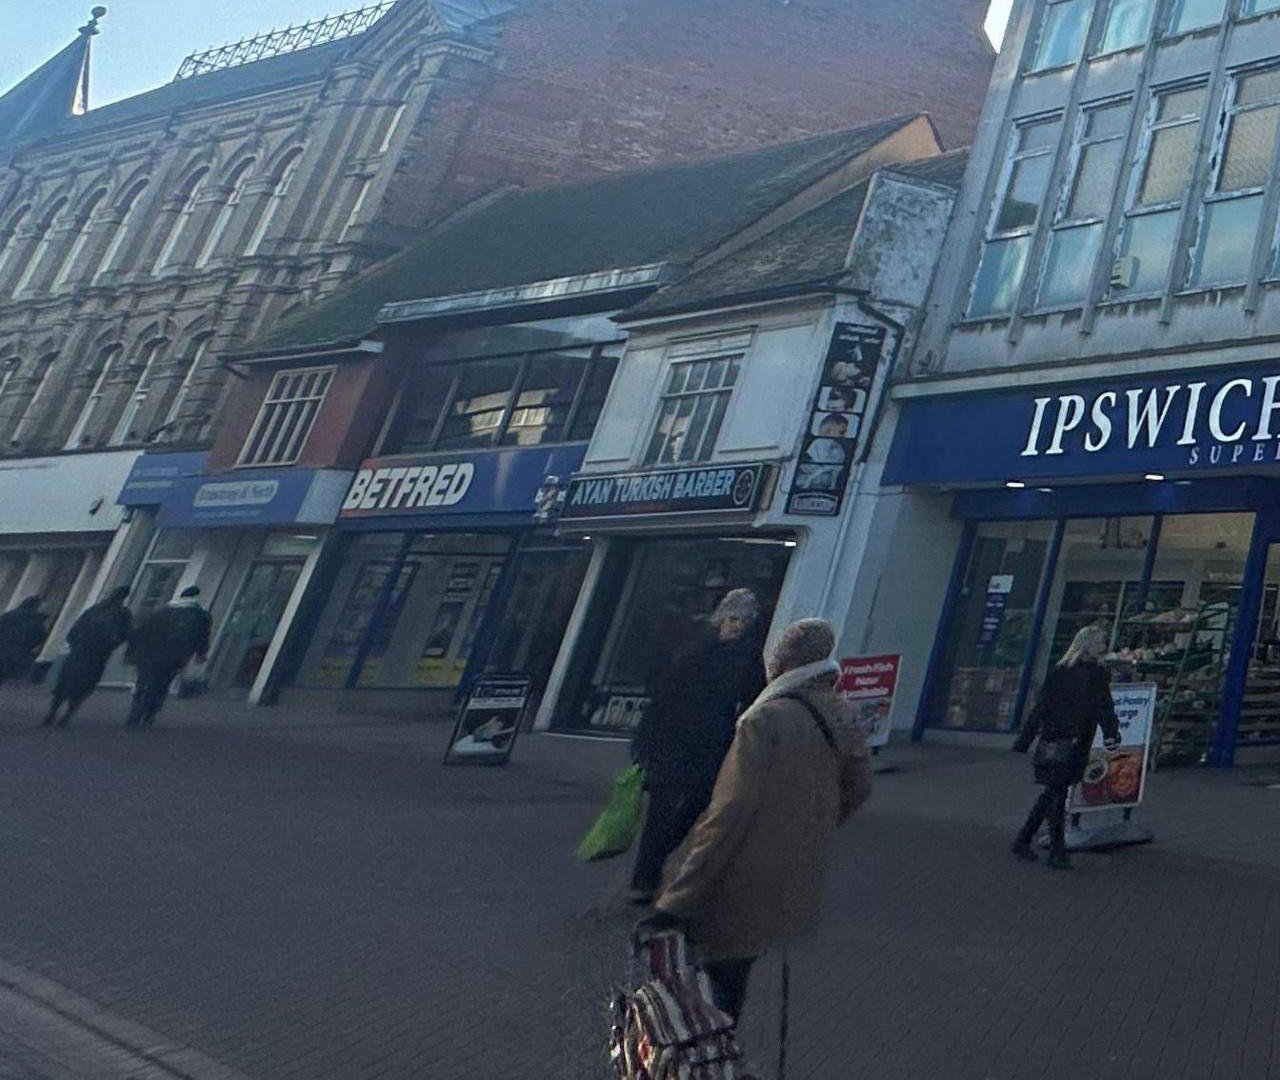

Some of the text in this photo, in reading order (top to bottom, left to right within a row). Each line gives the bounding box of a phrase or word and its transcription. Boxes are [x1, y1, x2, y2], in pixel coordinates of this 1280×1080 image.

[342, 462, 475, 510] BETFRED
[571, 478, 614, 505] AYAN
[614, 474, 673, 503] TURKISH
[671, 468, 735, 499] BARBER
